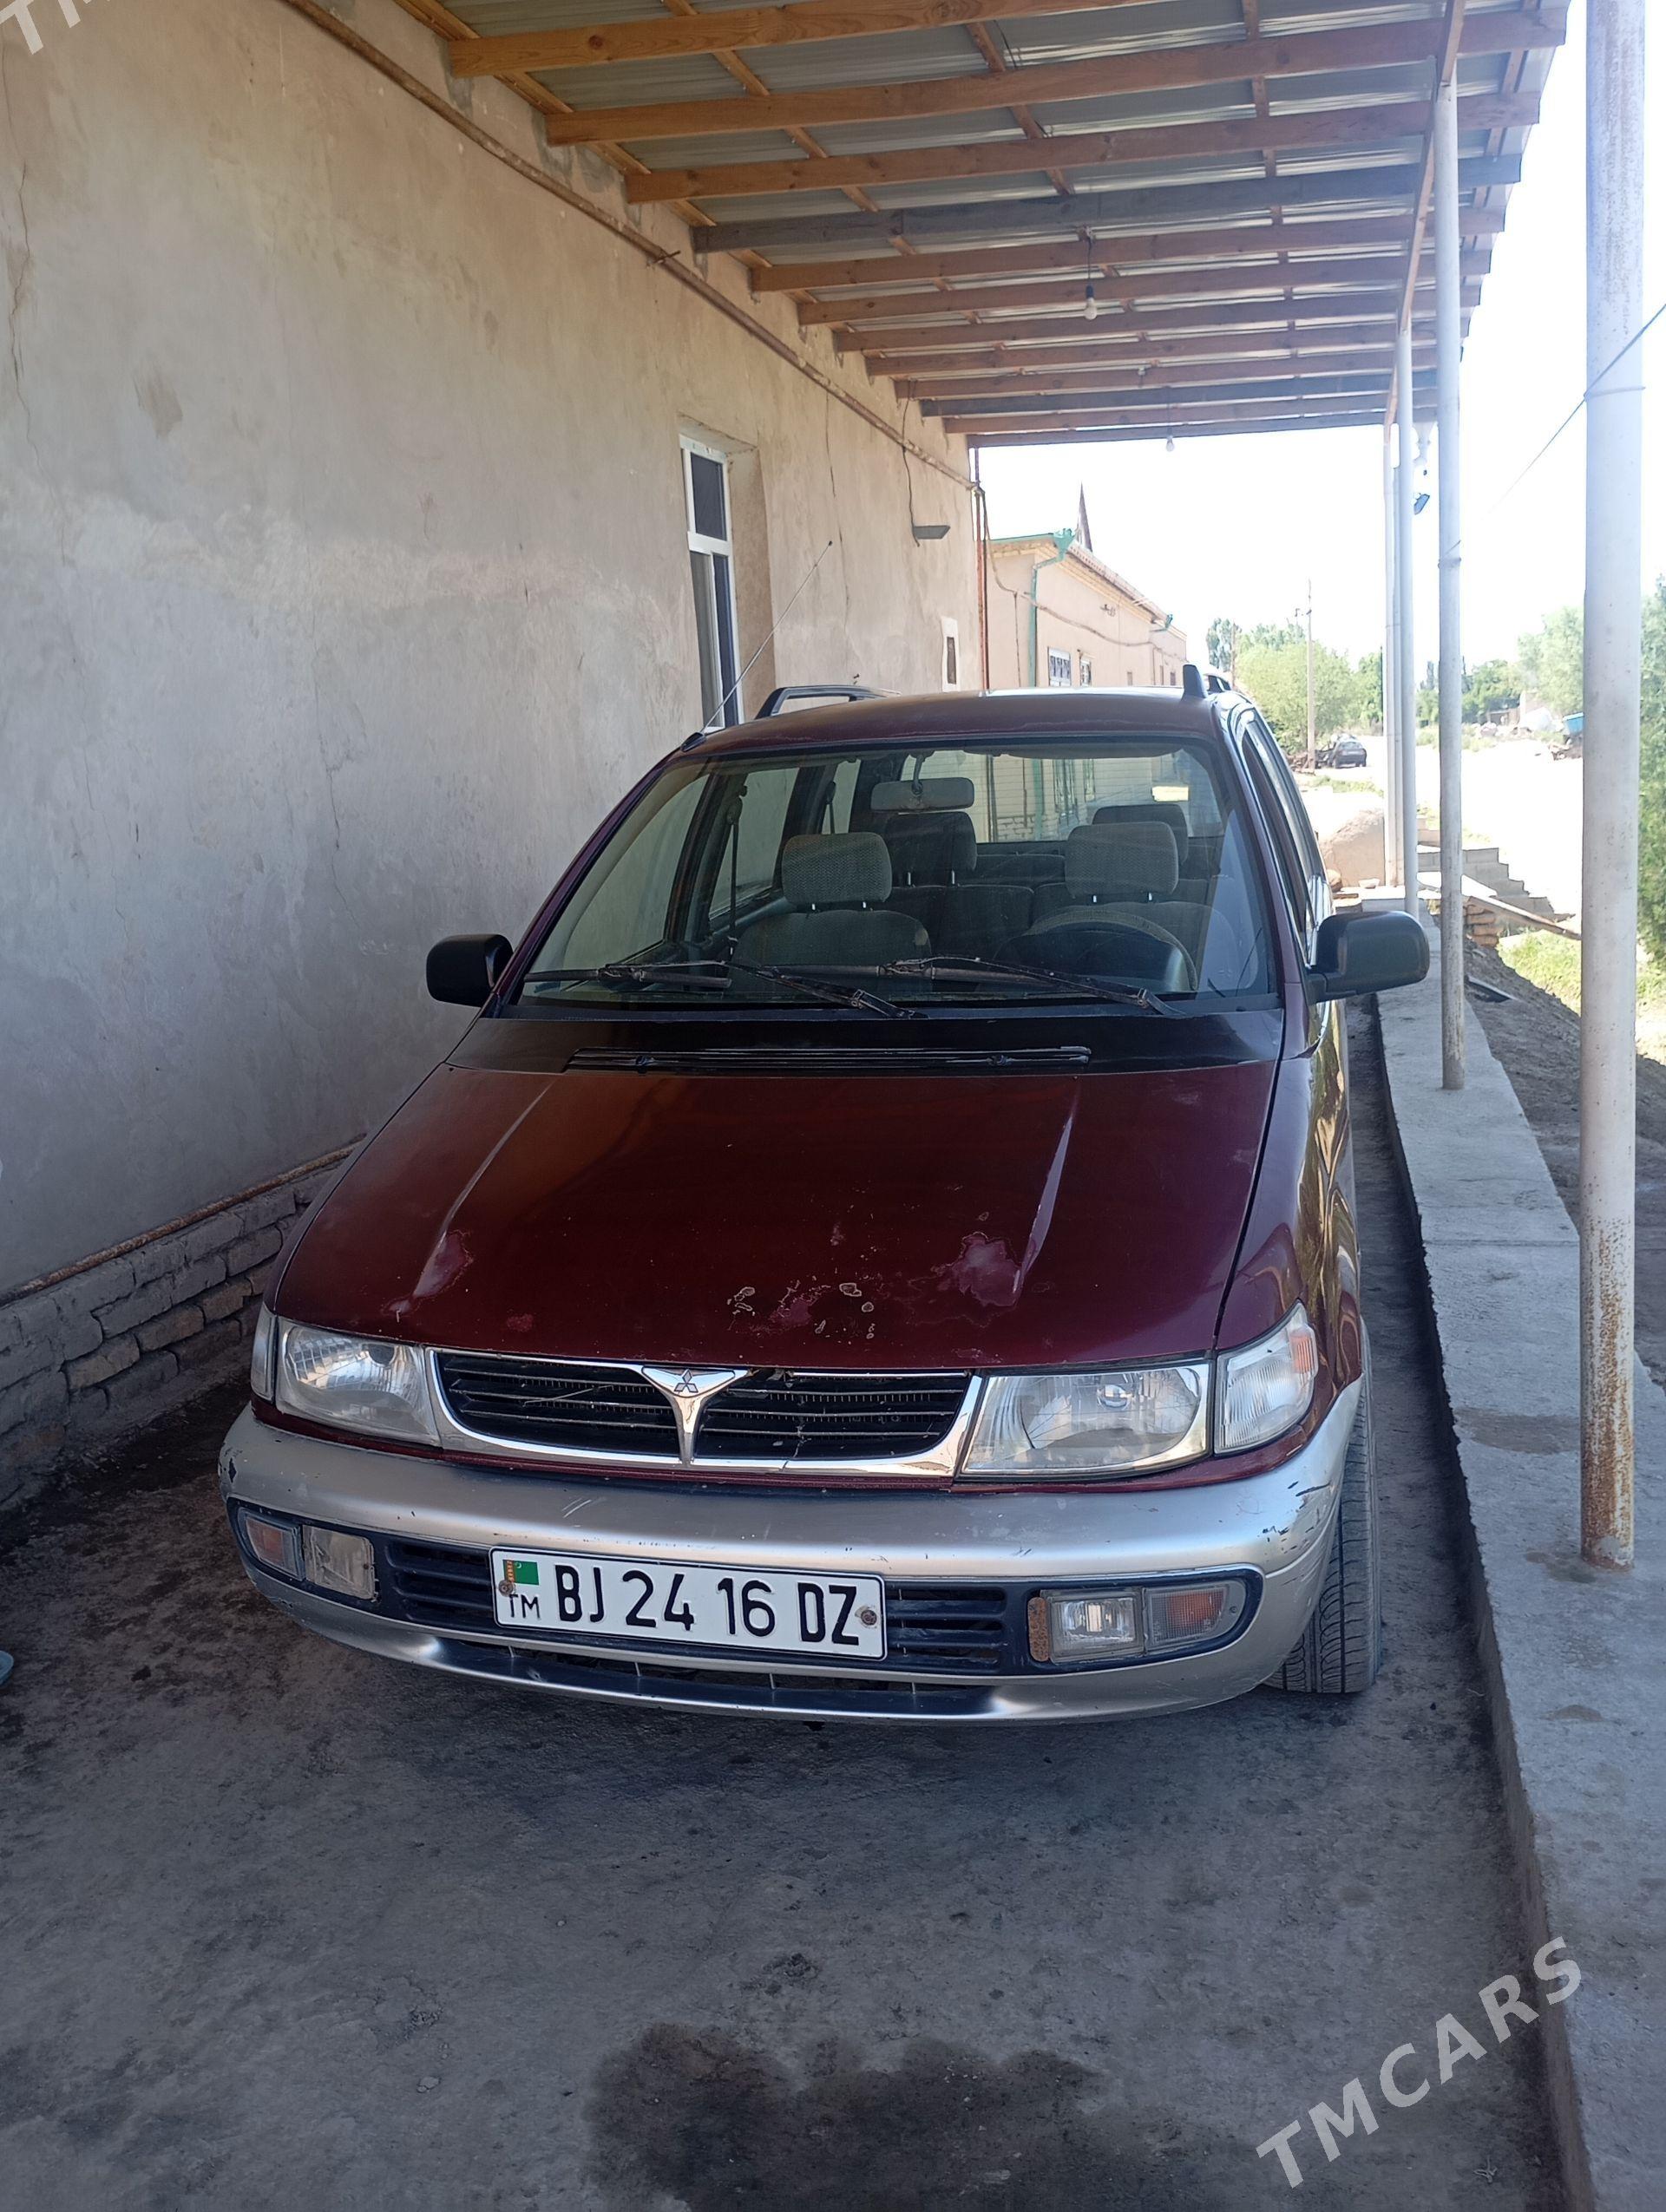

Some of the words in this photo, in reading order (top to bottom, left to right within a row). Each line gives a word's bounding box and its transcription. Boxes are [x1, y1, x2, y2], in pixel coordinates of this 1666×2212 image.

[508, 1594, 540, 1619] TM
[554, 1564, 604, 1623] BJ
[622, 1570, 695, 1631] 24
[717, 1578, 776, 1638] 16
[797, 1582, 859, 1646] DZ
